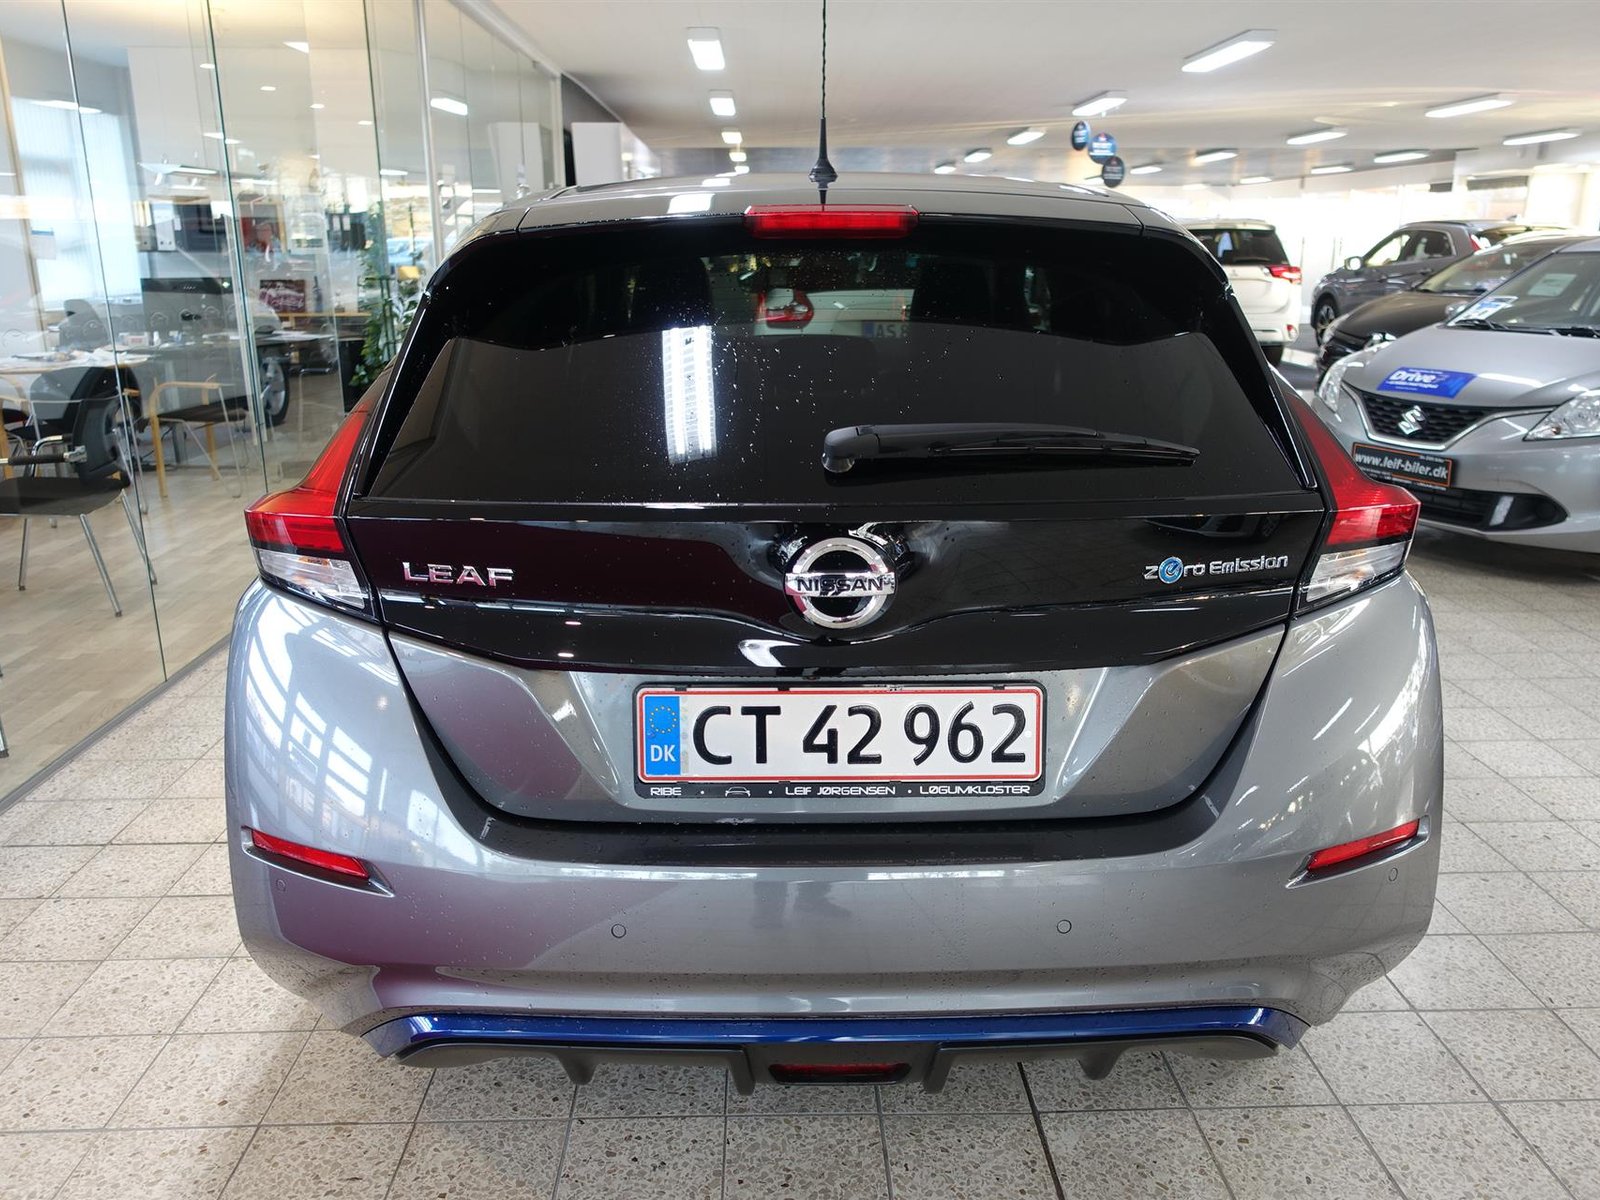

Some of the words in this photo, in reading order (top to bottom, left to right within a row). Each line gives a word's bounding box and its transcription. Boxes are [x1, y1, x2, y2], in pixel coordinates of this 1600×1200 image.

[1389, 369, 1437, 383] Drive
[1354, 453, 1449, 479] www.leif-biler.dk
[402, 561, 515, 587] LEAF
[1209, 555, 1289, 575] Emission
[796, 577, 884, 593] NISSAN
[692, 704, 783, 766] CT
[801, 703, 883, 765] 42
[903, 700, 1027, 767] 962
[650, 744, 677, 762] DK
[650, 786, 682, 796] RIBE
[785, 786, 812, 796] LEIF
[816, 786, 896, 796] JØRGENSEN
[919, 784, 1031, 795] LØGUMKLOSTER
